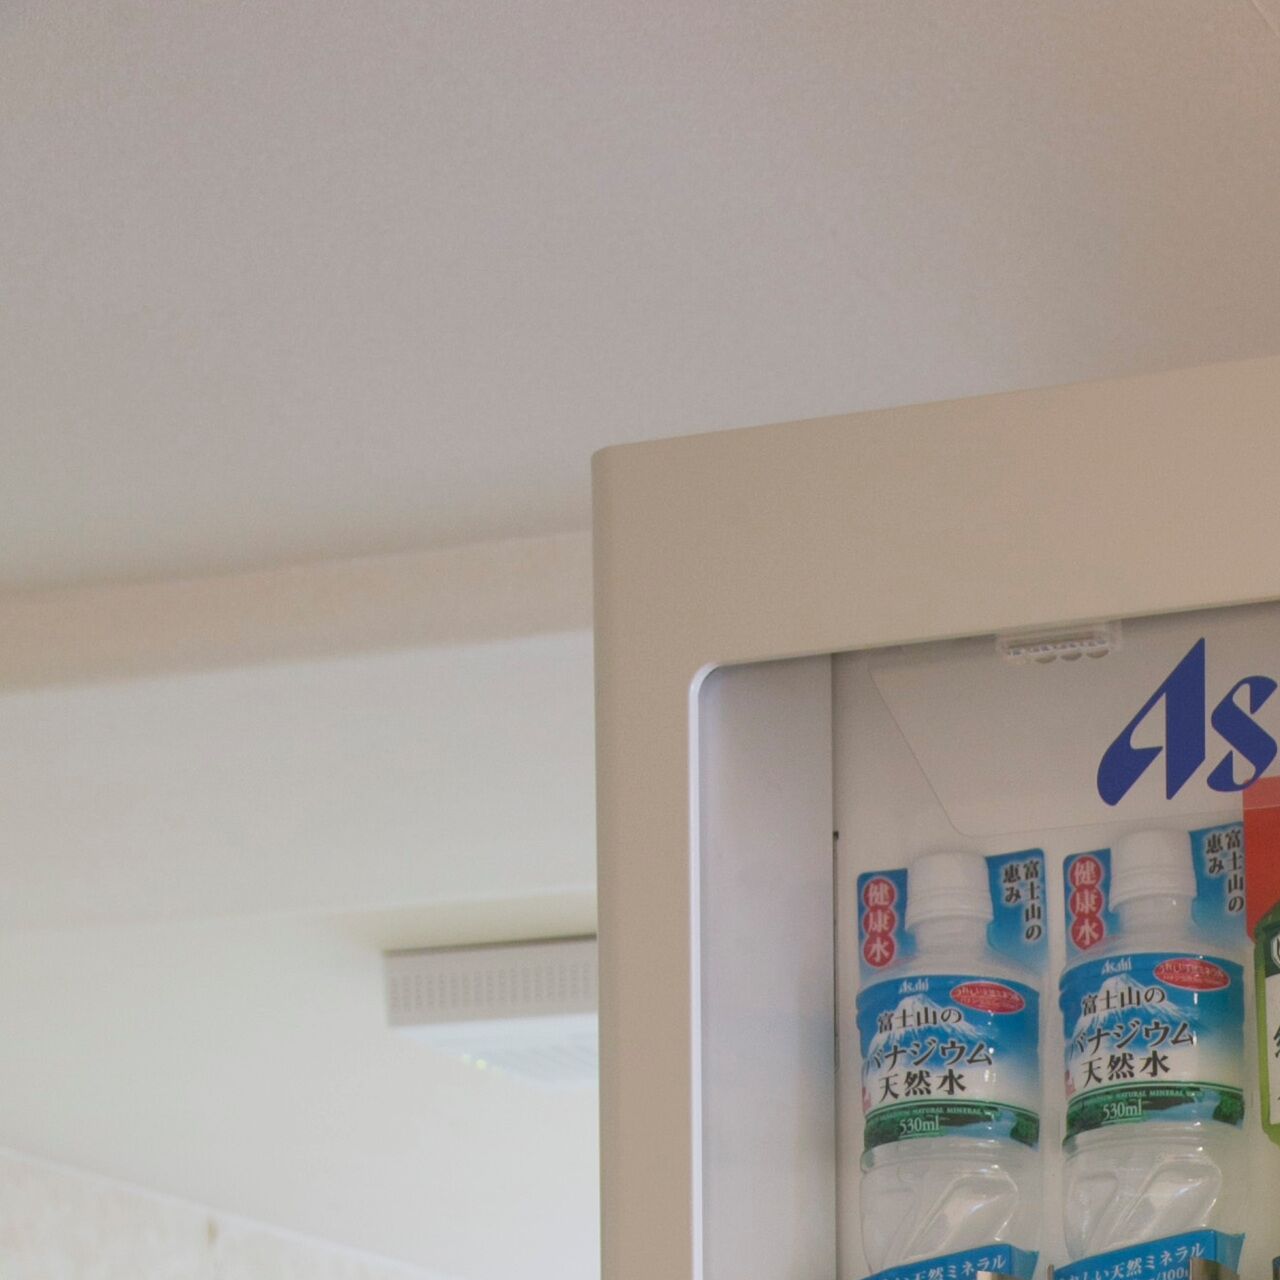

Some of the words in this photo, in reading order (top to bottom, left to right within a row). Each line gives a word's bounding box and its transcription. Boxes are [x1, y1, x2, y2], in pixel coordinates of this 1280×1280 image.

[1206, 833, 1224, 874] 恵み
[1224, 829, 1244, 913] 富士山の
[1003, 863, 1022, 904] 恵み
[1023, 859, 1043, 942] 富士山の
[1069, 859, 1101, 944] 健康水
[864, 882, 895, 963] 健康水
[878, 1007, 962, 1034] 富士山の
[1083, 986, 1165, 1016] 富士山の
[866, 1039, 993, 1076] バナジウム
[1070, 1020, 1195, 1060] バナジウム
[879, 1069, 967, 1102] 天然水
[1083, 1050, 1171, 1088] 天然水
[898, 1115, 939, 1135] 530ml
[1103, 1099, 1143, 1120] 530ml
